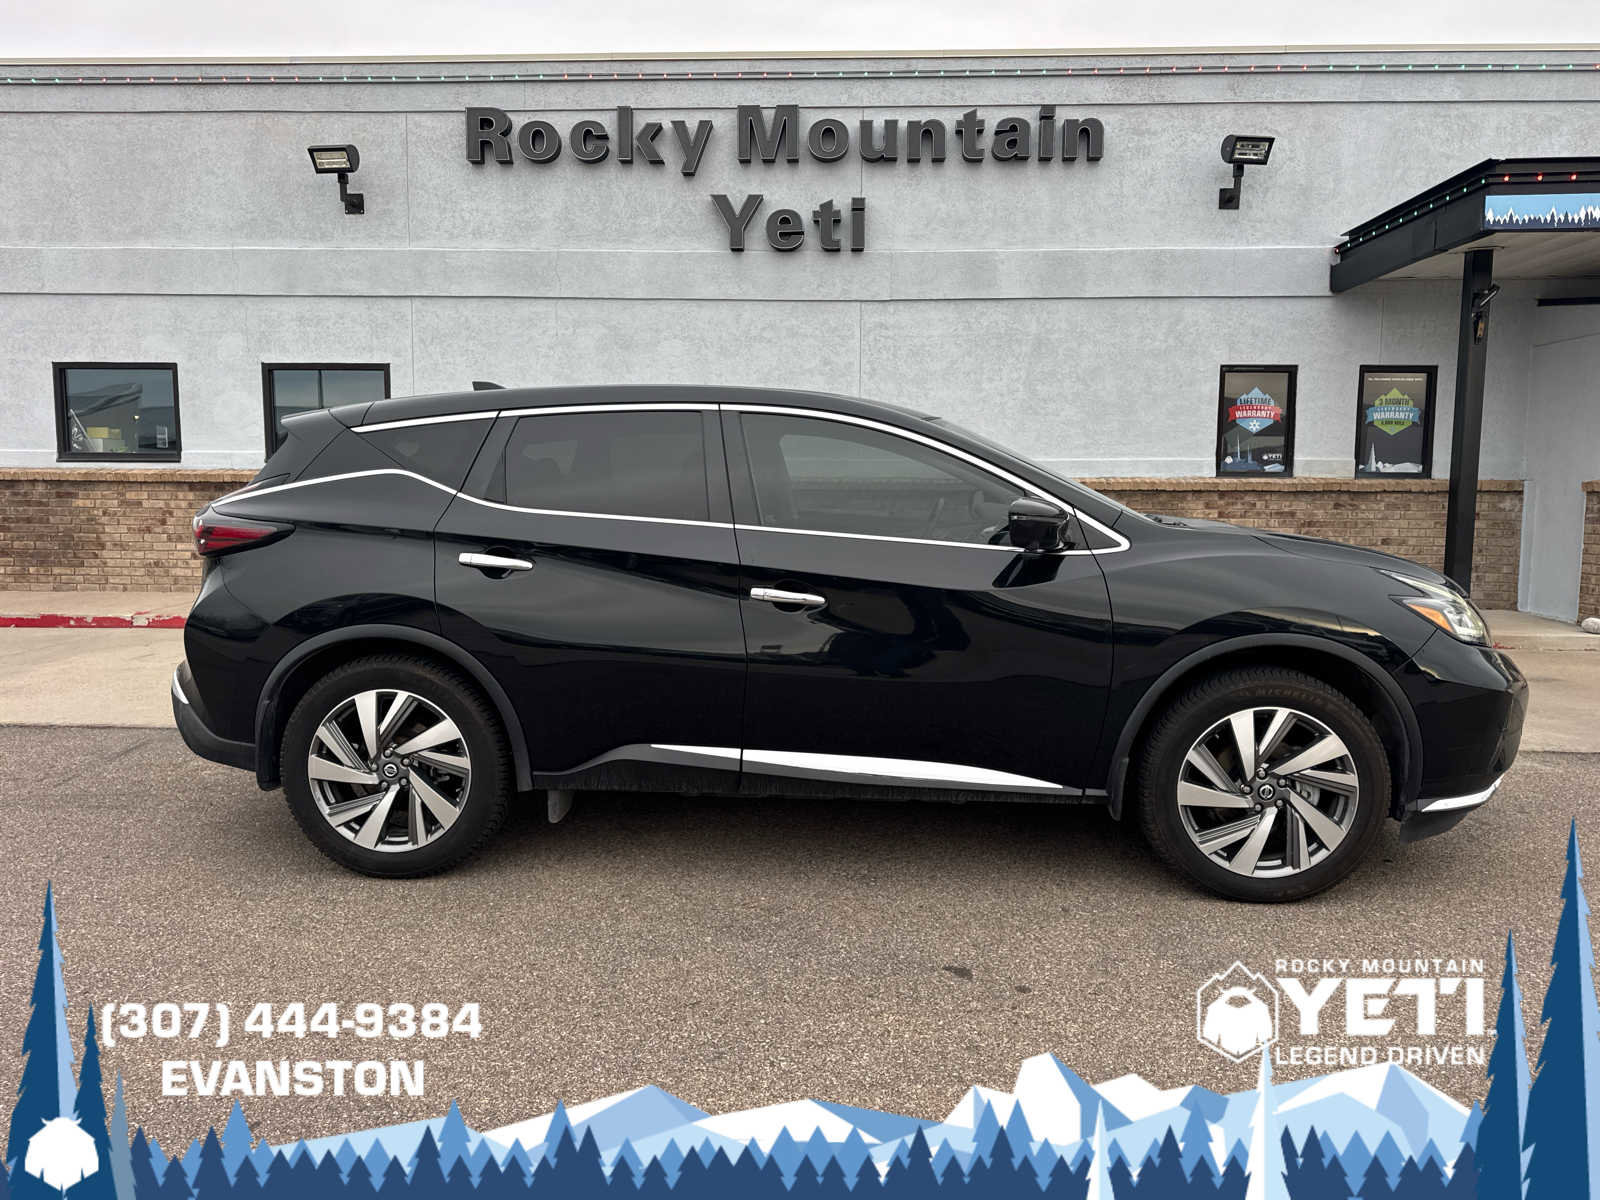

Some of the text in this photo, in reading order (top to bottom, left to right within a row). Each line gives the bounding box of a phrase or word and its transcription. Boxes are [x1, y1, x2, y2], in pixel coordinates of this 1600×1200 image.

[465, 103, 1105, 177] Rocky Mountain
[711, 193, 866, 253] Yeti
[1239, 397, 1272, 405] LIFETIME
[1235, 410, 1276, 418] WARRANTY
[1373, 411, 1414, 420] WARRANTY
